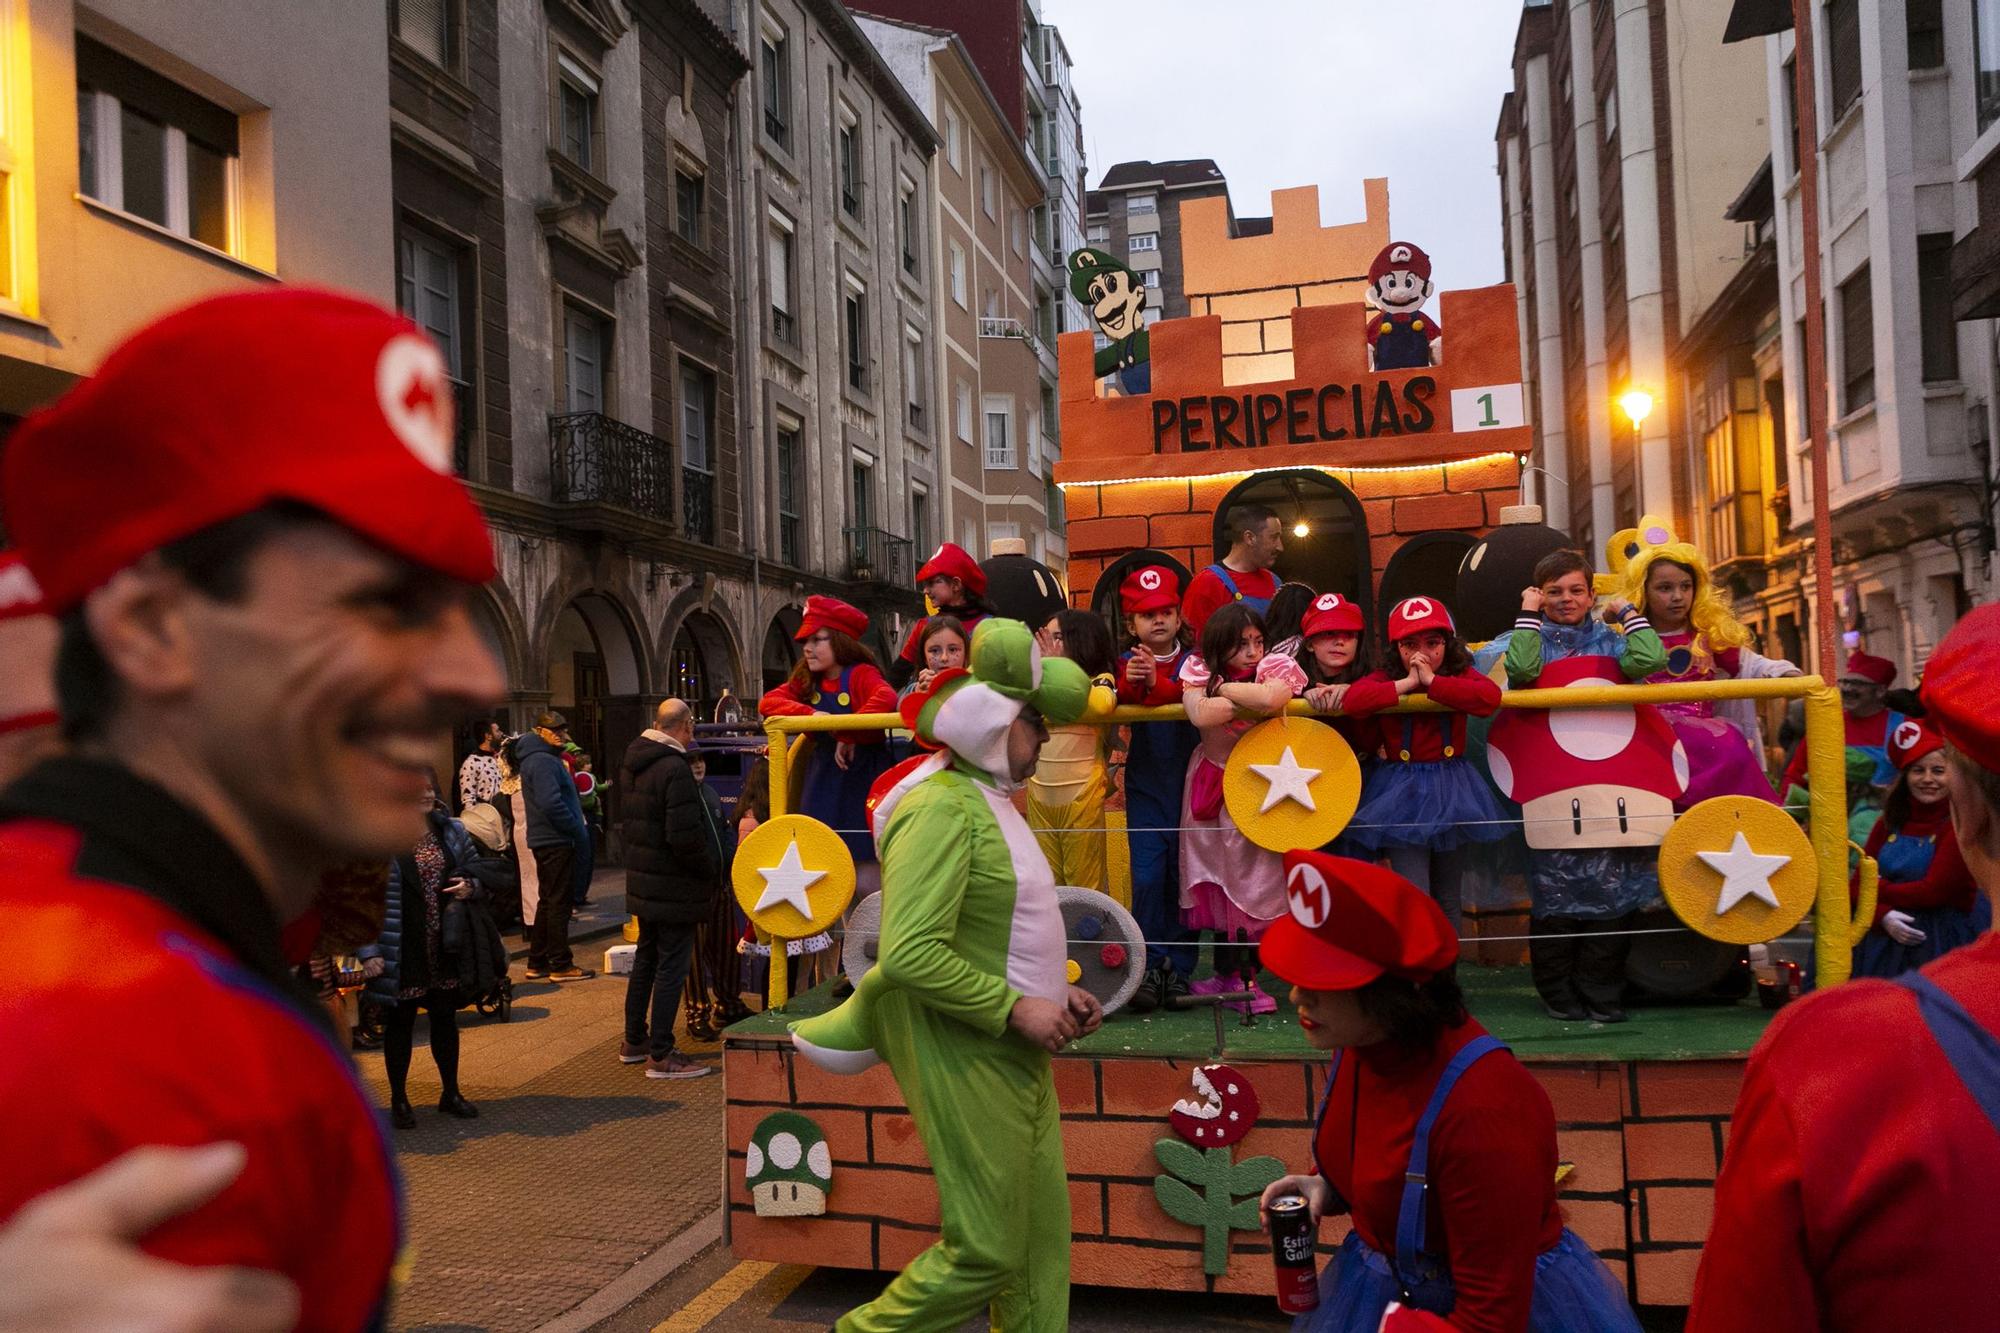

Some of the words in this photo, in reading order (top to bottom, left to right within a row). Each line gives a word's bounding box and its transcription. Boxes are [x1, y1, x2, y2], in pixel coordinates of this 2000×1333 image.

[1152, 376, 1436, 454] PERIPECIAS
[1476, 392, 1500, 427] 1
[1406, 600, 1430, 617] M
[1289, 866, 1324, 925] M
